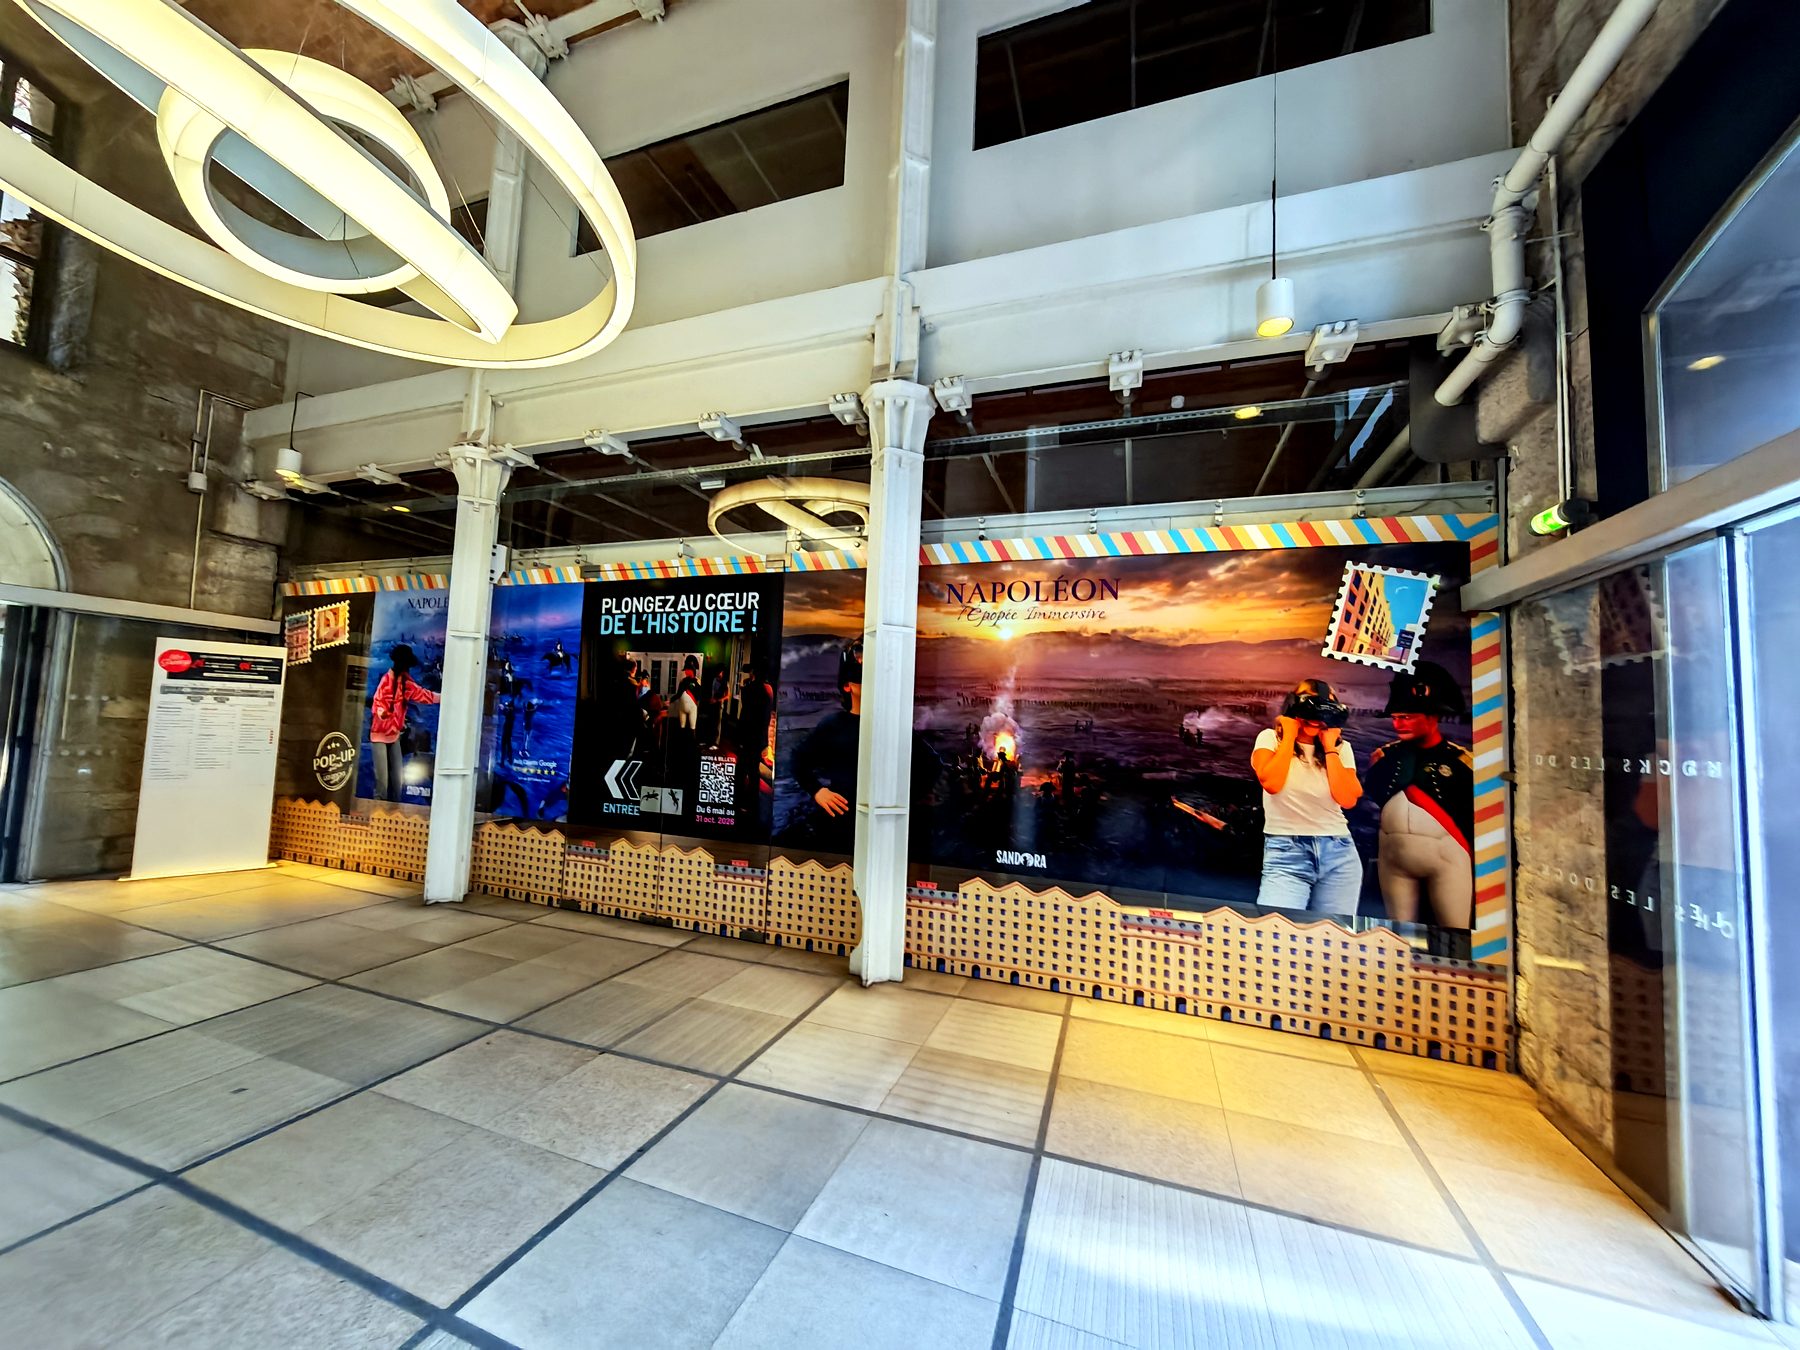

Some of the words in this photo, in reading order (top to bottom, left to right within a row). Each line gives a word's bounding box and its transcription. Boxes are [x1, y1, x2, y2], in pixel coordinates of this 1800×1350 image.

[946, 575, 1121, 604] NAPOLÉON
[601, 596, 675, 614] PLONGEZ
[677, 594, 701, 611] AU
[705, 592, 760, 610] CŒUR
[600, 614, 626, 635] DE
[631, 611, 745, 635] L'HISTOIRE
[751, 610, 758, 632] !
[1024, 606, 1107, 621] Immersive
[312, 748, 356, 771] POP-UP
[538, 759, 558, 770] Google
[603, 802, 641, 816] ENTRÉE
[696, 804, 706, 813] Du
[712, 806, 726, 816] mai
[726, 808, 735, 816] au
